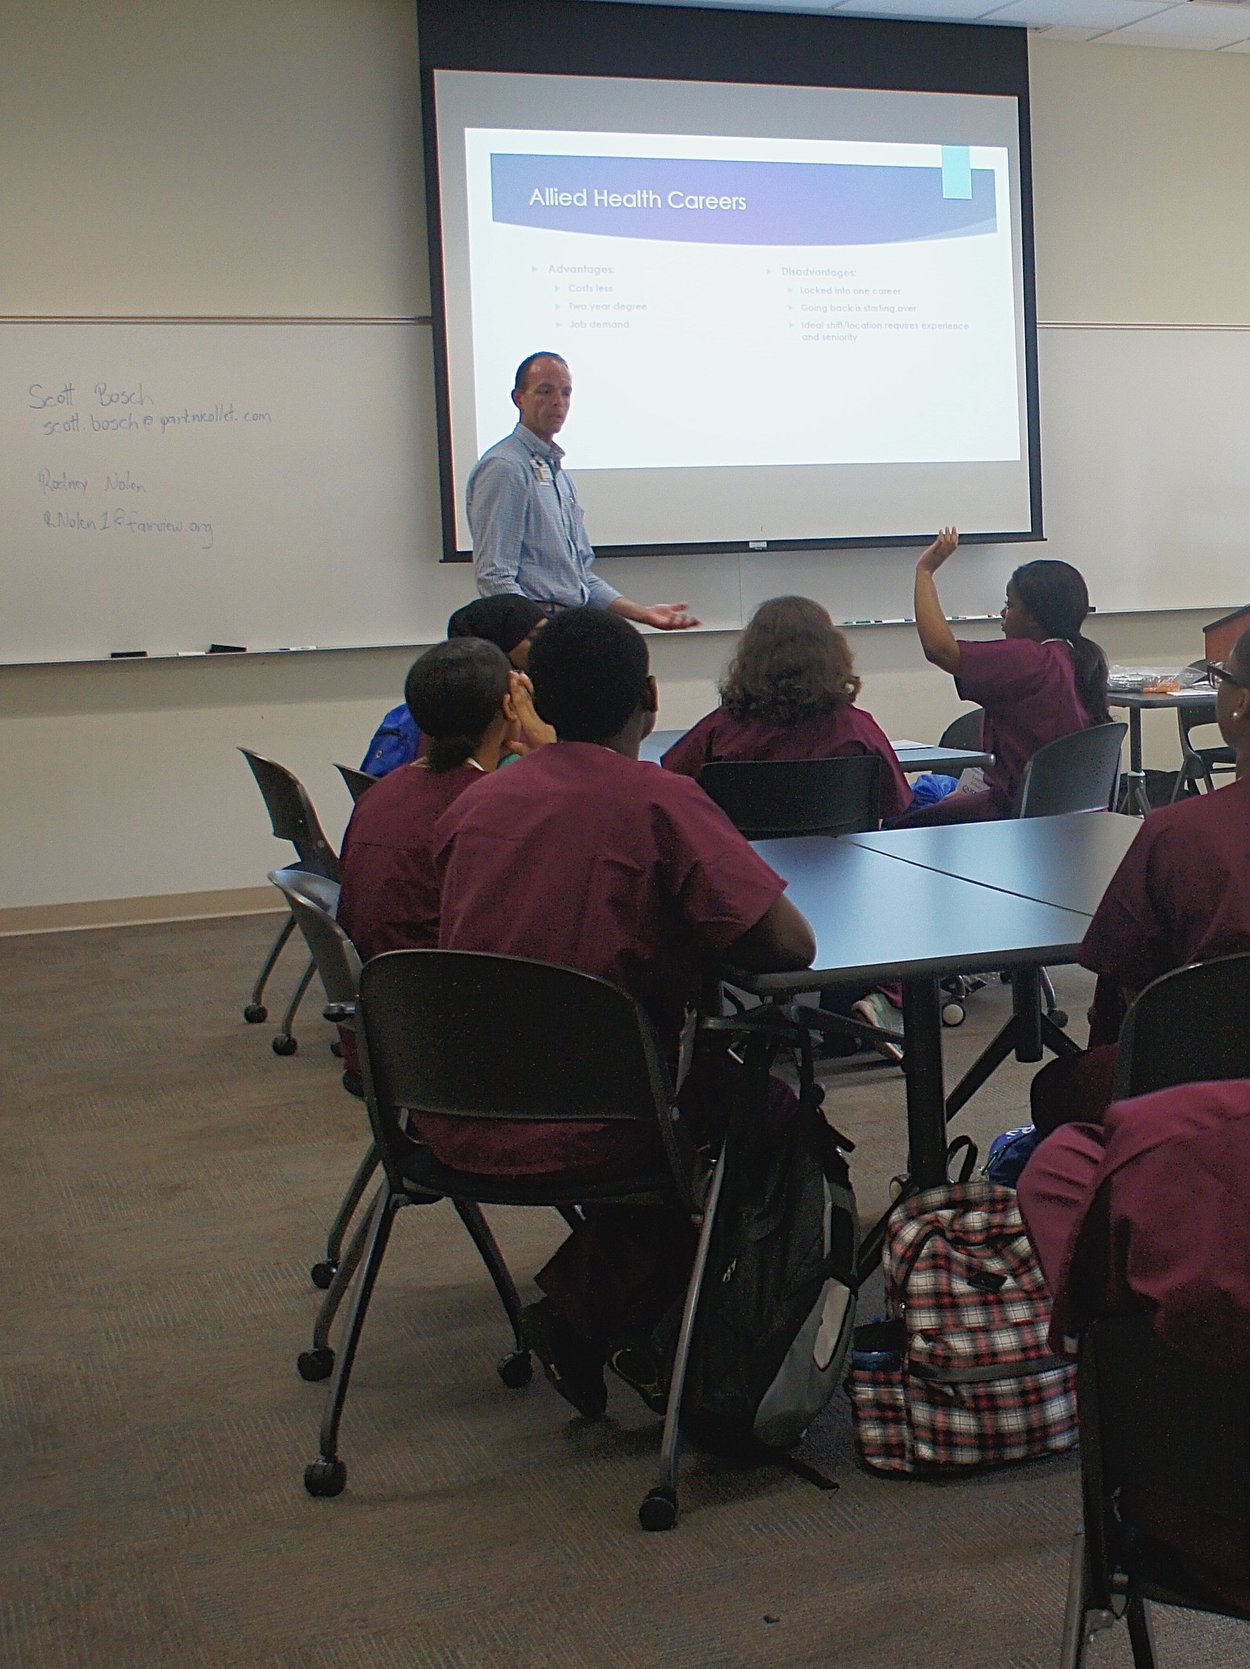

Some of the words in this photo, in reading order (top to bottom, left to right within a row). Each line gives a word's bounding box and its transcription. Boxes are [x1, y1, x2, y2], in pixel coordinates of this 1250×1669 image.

[529, 187, 588, 208] Allied
[594, 189, 662, 209] Health
[668, 191, 747, 211] Careers
[548, 264, 616, 276] Advantages:
[781, 267, 857, 279] Disadvantages:
[568, 284, 593, 293] Costs
[596, 284, 614, 293] less
[800, 287, 832, 296] Locked
[834, 287, 851, 295] into
[853, 288, 870, 296] one
[872, 288, 902, 296] career
[568, 302, 587, 311] Two
[590, 303, 611, 313] year
[613, 302, 648, 313] degree
[800, 304, 828, 314] Going
[830, 304, 853, 313] back
[855, 304, 862, 313] is
[864, 304, 895, 314] starting
[898, 305, 917, 313] over
[569, 320, 587, 329] Job
[589, 320, 630, 329] demand
[801, 321, 824, 330] Ideal
[826, 321, 883, 331] shift/location
[884, 322, 919, 332] requires
[921, 322, 969, 332] experience
[802, 333, 820, 342] and
[822, 333, 858, 344] seniority
[28, 382, 76, 409] Scott
[94, 382, 155, 406] Bosch
